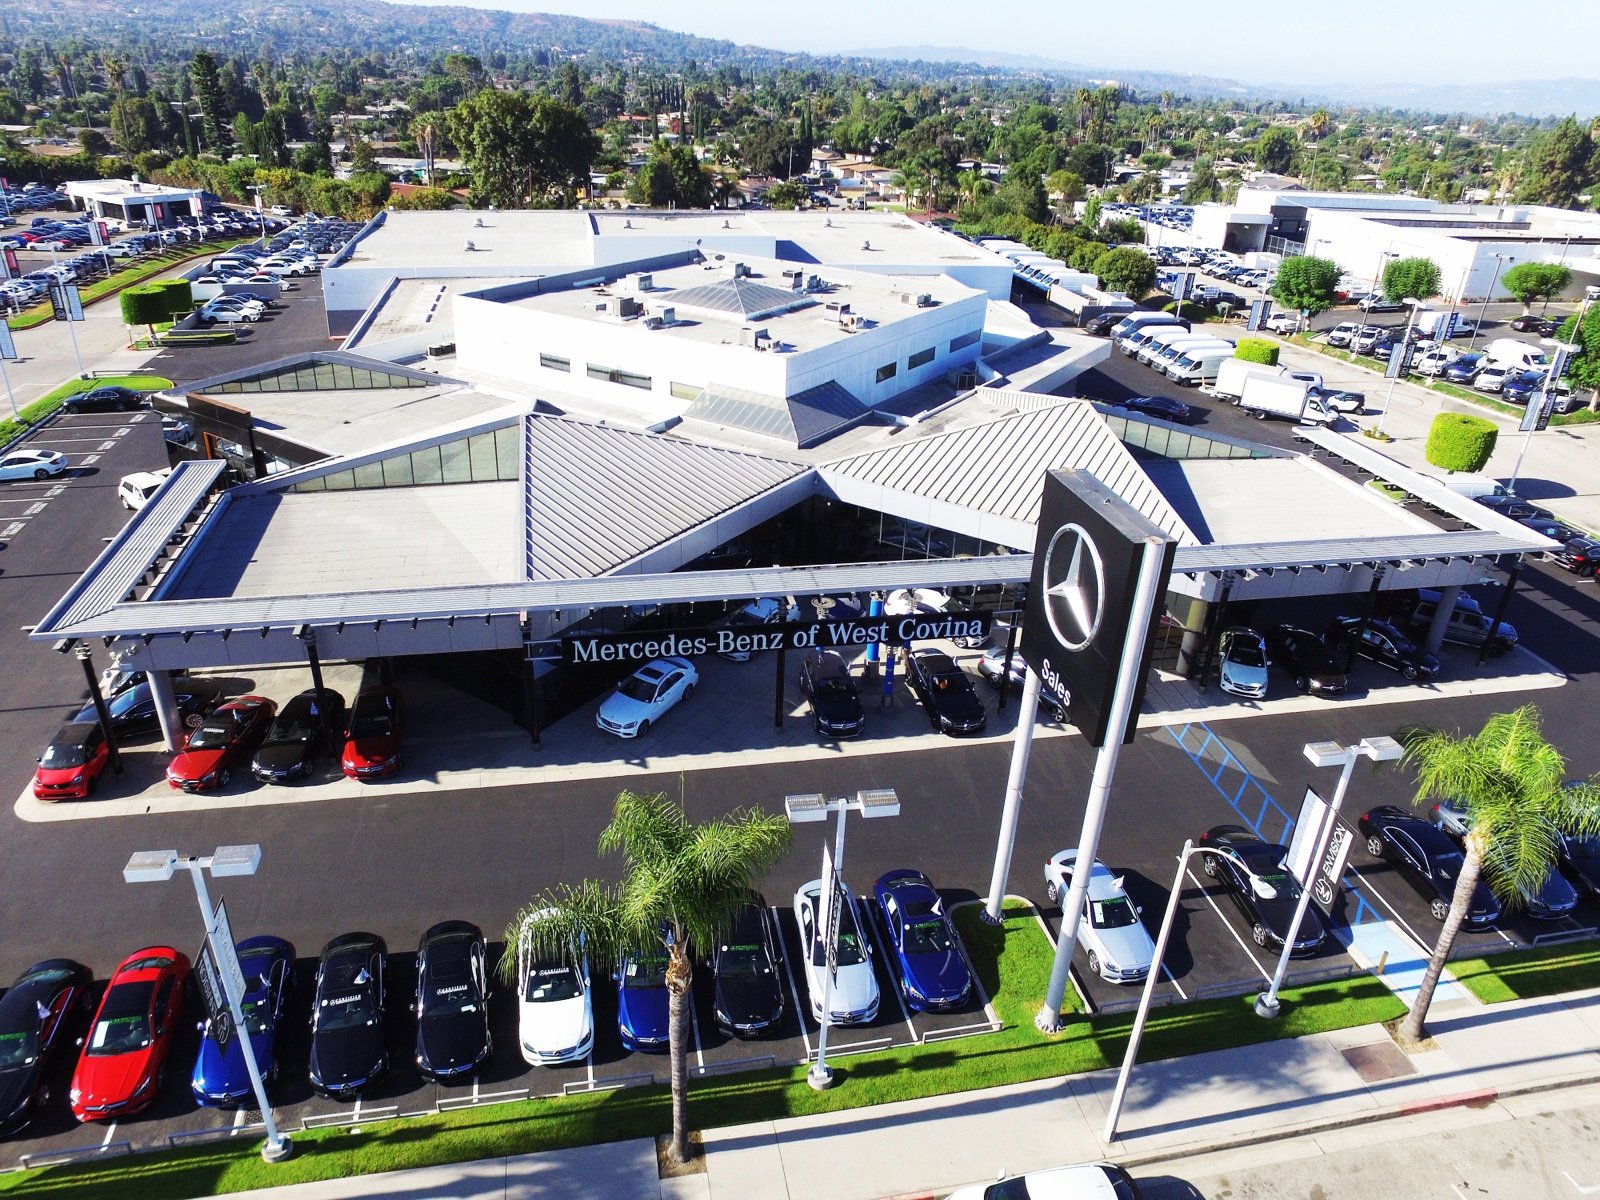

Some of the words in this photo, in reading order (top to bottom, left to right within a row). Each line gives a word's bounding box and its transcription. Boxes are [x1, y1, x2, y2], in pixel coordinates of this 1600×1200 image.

[572, 630, 784, 663] Mercedes-Benz
[793, 624, 820, 647] of
[827, 621, 889, 645] West
[898, 616, 983, 641] Covina
[1041, 658, 1071, 707] Sales
[1322, 822, 1346, 876] ENVISION
